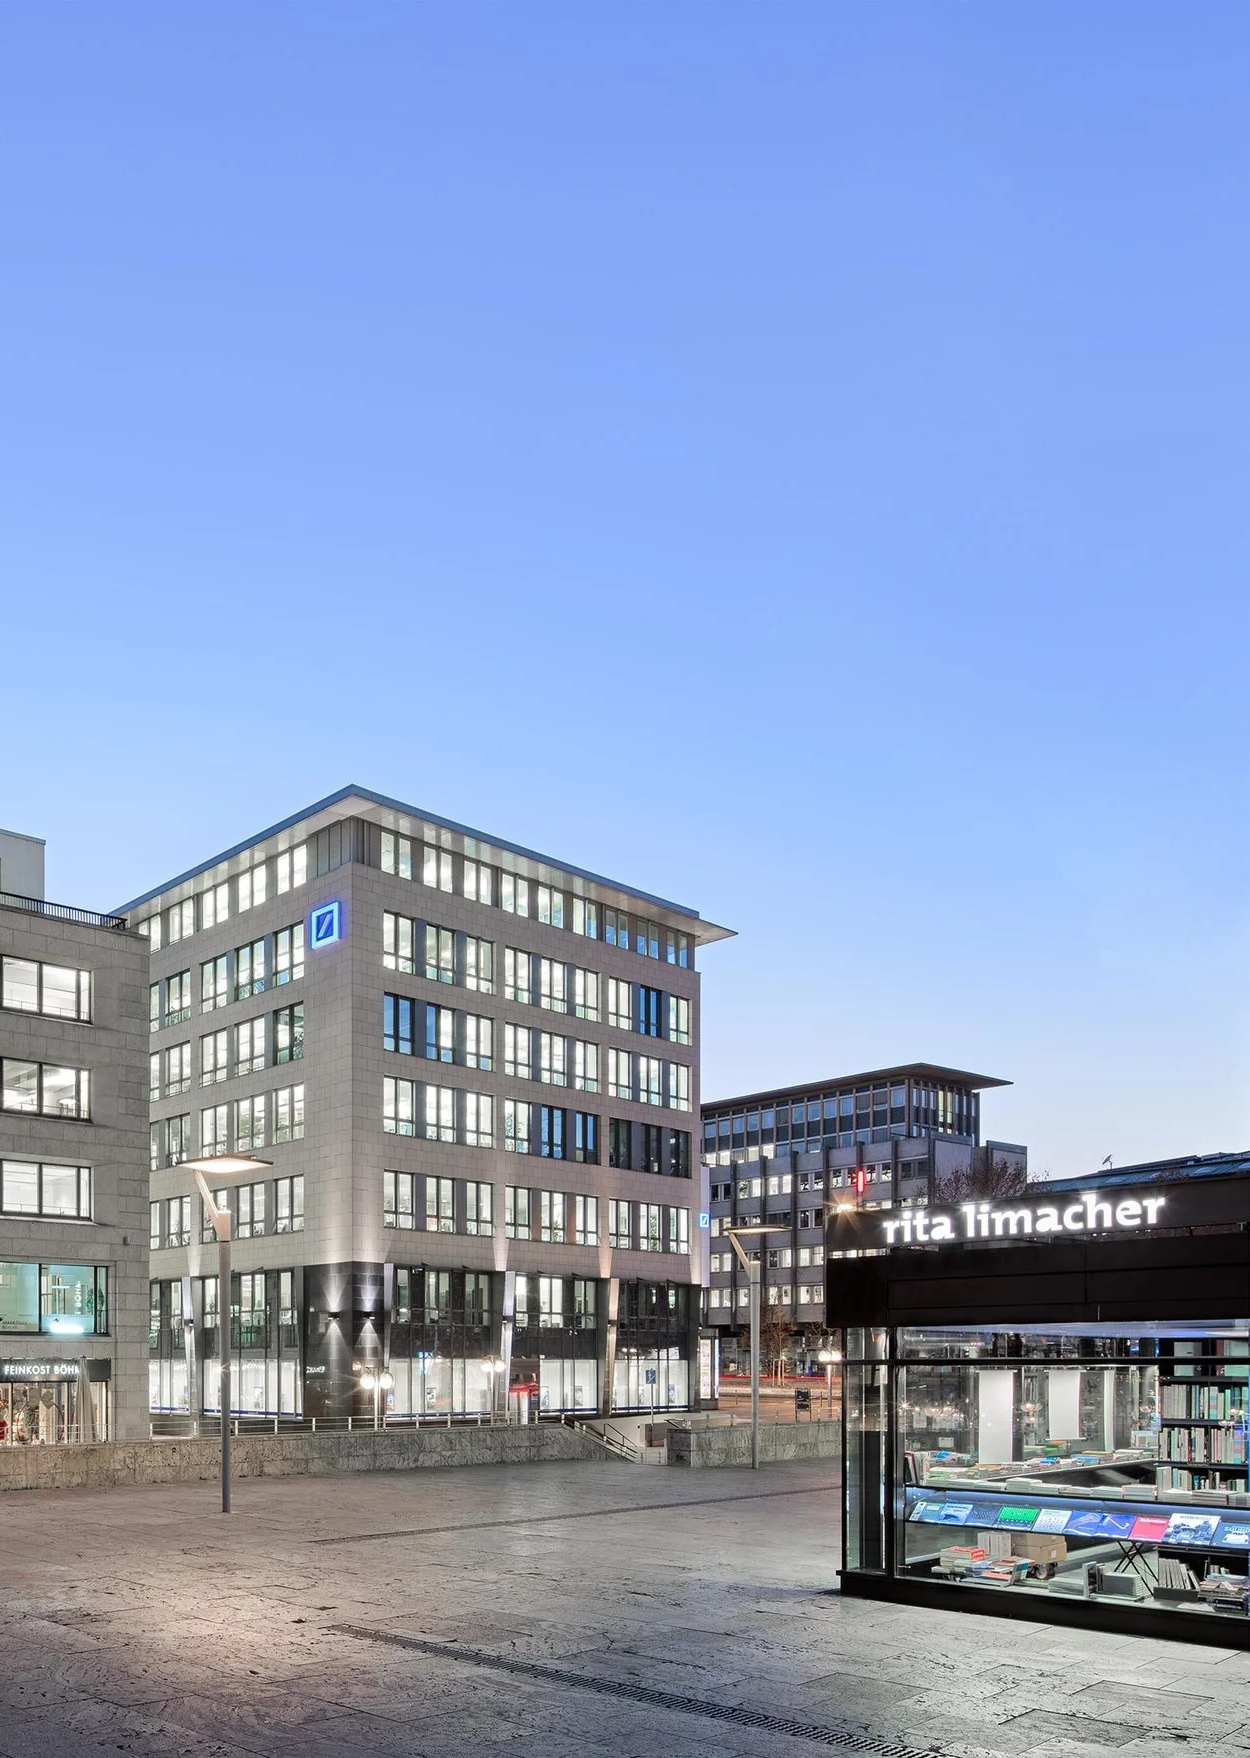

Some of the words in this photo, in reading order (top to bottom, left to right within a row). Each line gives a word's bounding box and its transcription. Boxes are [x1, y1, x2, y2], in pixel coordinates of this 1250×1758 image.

[882, 1210, 955, 1243] rita
[963, 1194, 1165, 1238] limacher
[4, 1365, 50, 1375] FEINKOST
